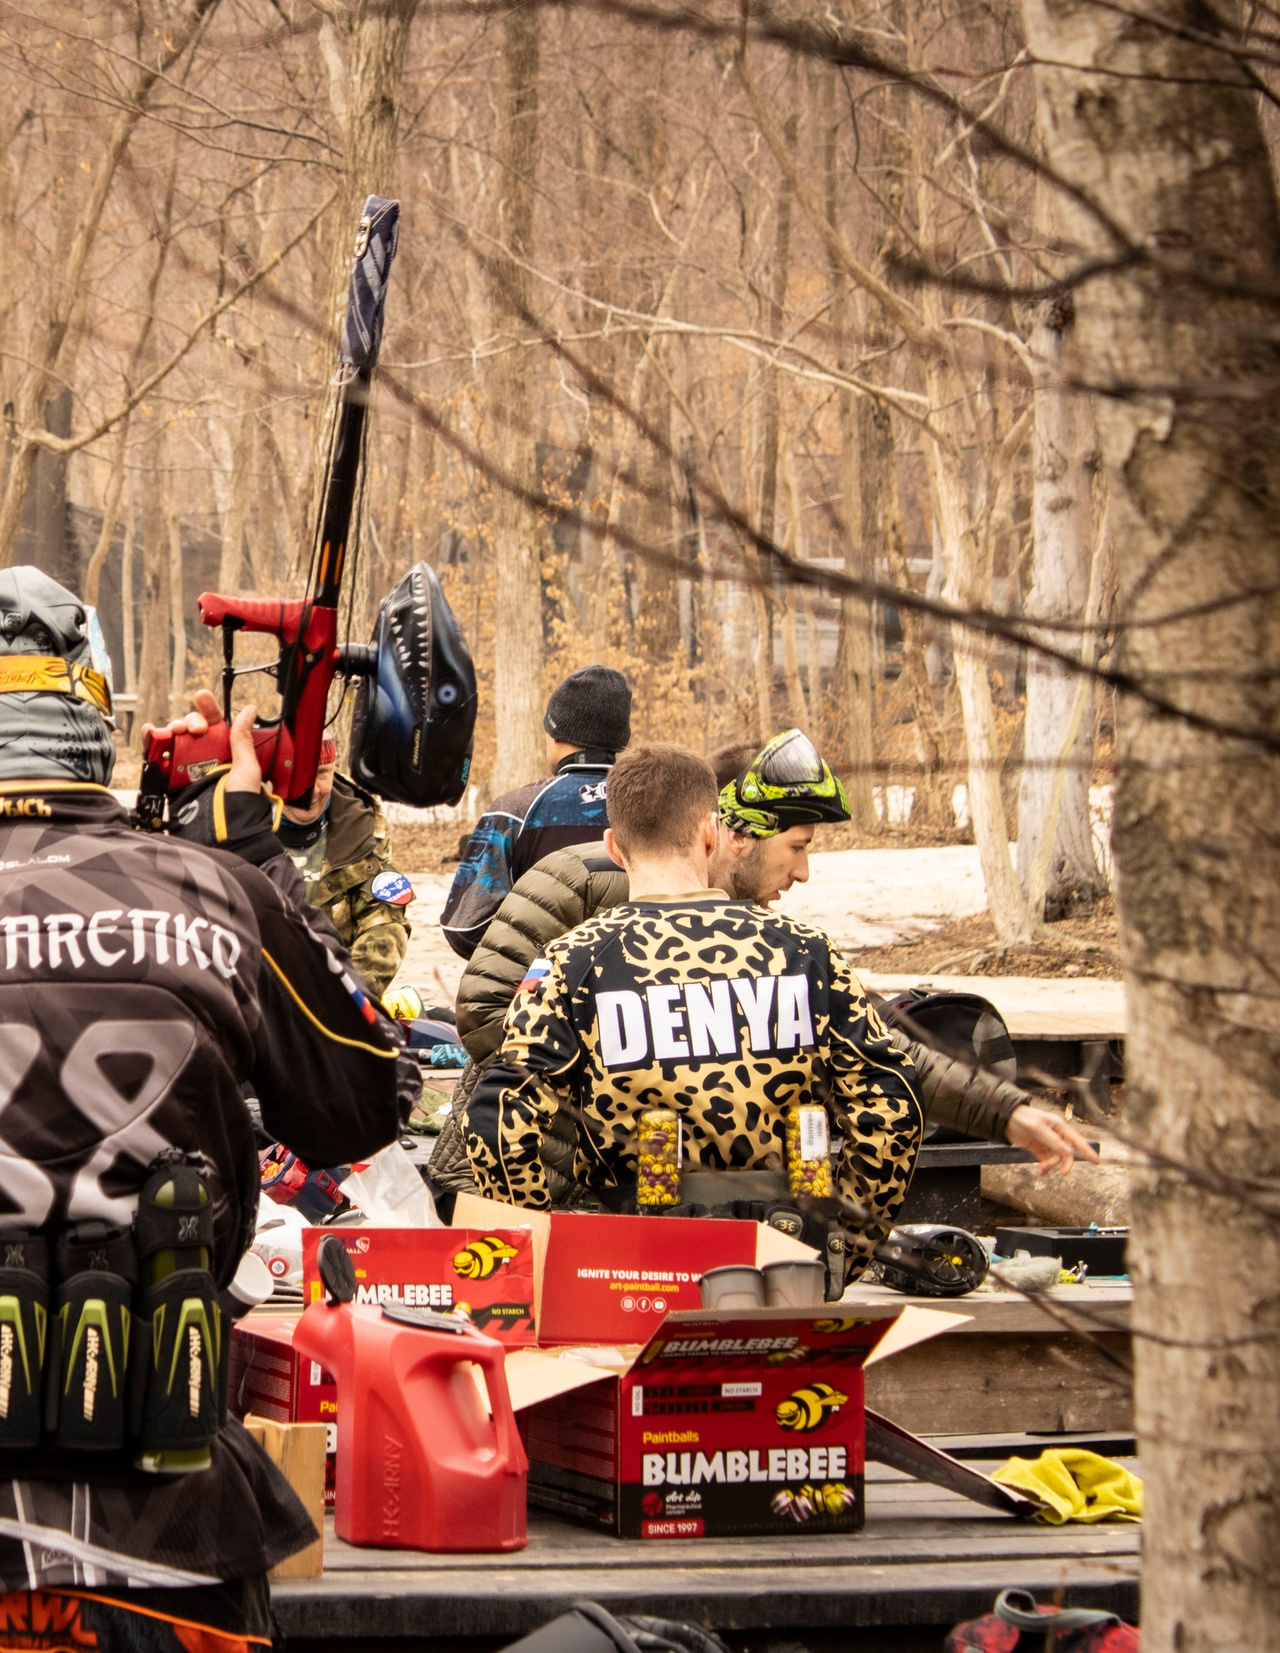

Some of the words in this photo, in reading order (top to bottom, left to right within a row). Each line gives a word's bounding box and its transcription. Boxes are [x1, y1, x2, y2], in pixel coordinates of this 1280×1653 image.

[4, 854, 71, 869] SLALOM
[595, 973, 814, 1067] DENYA
[577, 1268, 610, 1279] IGNITE
[611, 1270, 640, 1280] YOUR
[641, 1271, 674, 1282] DESIRE
[676, 1272, 689, 1282] TO
[609, 1281, 680, 1293] art-paintball.com
[325, 1283, 453, 1306] MBLEBEE
[663, 1336, 799, 1353] BUMBLEBEE
[735, 1386, 758, 1394] STARCH
[643, 1431, 699, 1444] Paintballs
[643, 1446, 847, 1486] BUMBLEBEE
[648, 1524, 675, 1533] SINCE
[677, 1523, 698, 1533] 1997
